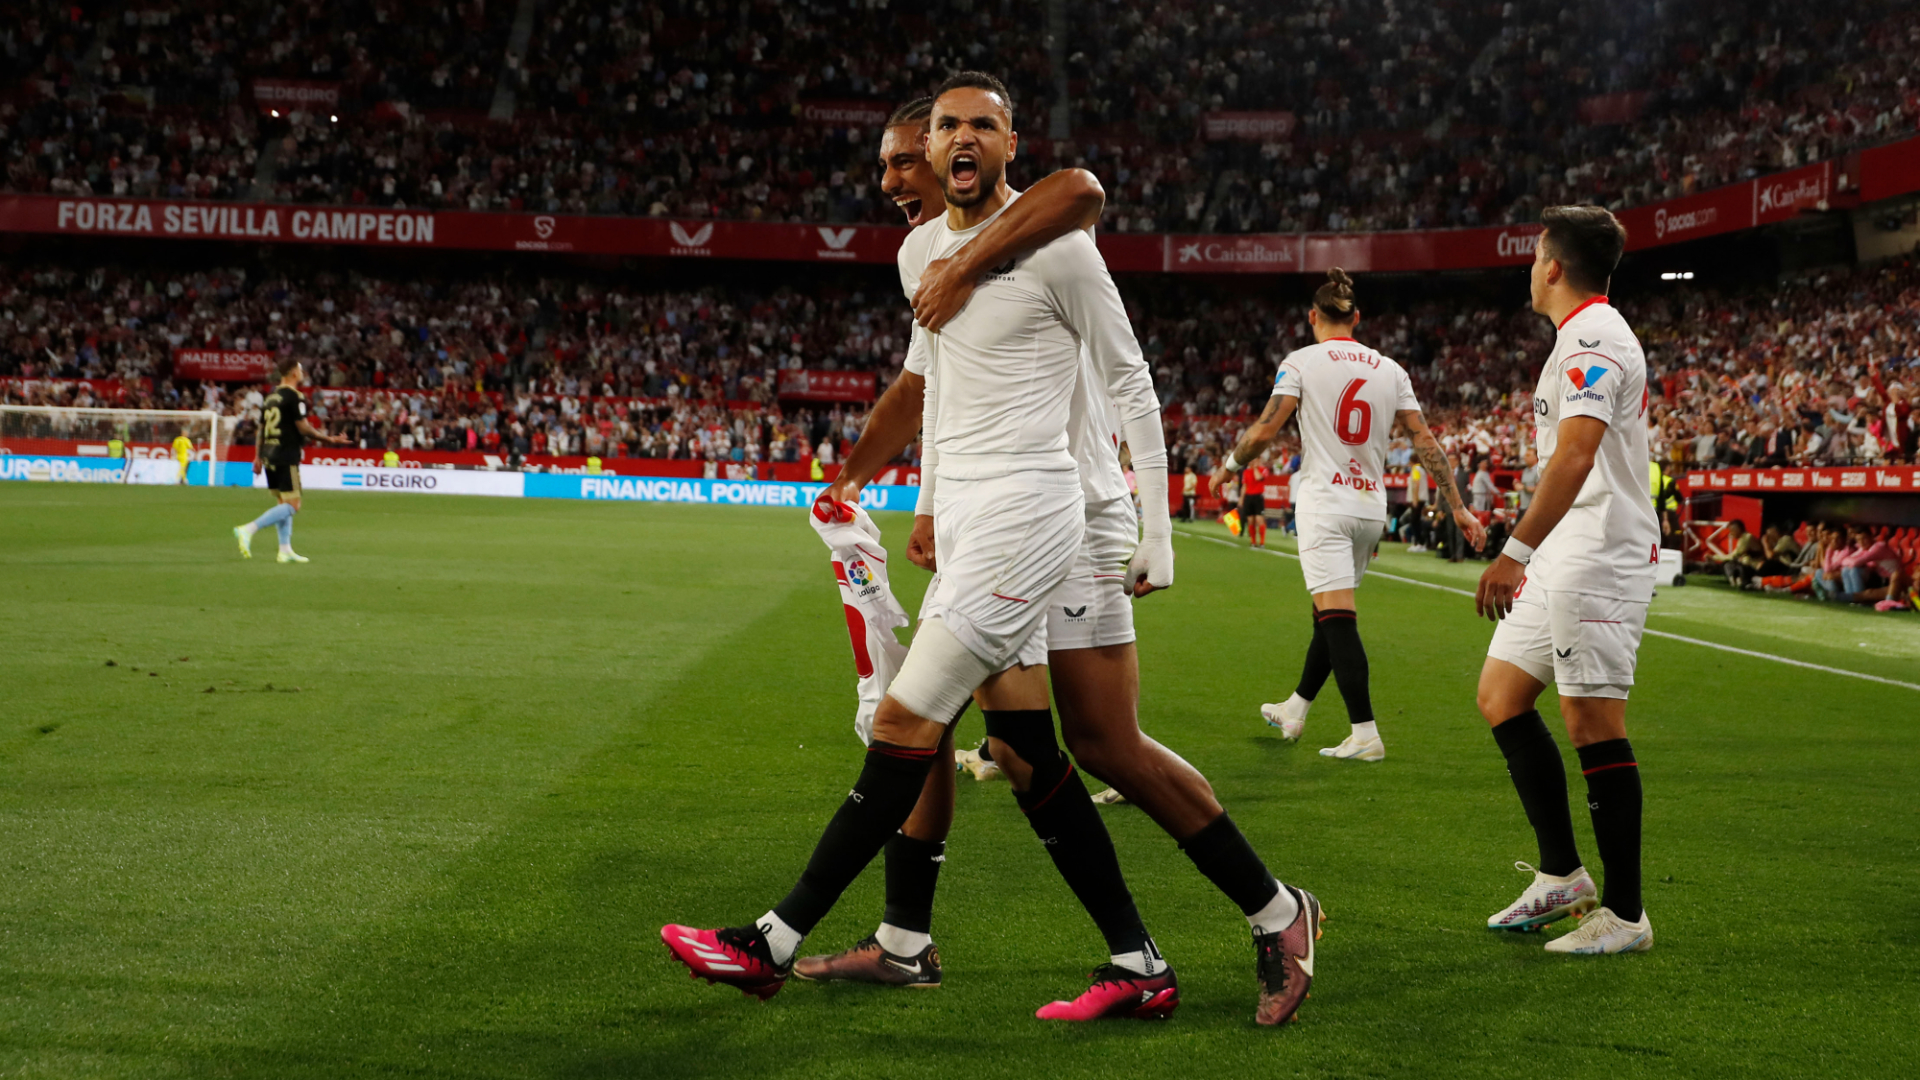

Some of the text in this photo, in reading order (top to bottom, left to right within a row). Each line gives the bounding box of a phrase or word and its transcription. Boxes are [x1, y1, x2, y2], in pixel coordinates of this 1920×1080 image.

[275, 86, 338, 101] DEGIRO
[58, 201, 435, 243] FORZA SEVILLA CAMPEON
[1204, 243, 1293, 263] CaixaBank
[985, 274, 1016, 282] CASTORE
[1327, 350, 1381, 370] GUDELJ
[1333, 377, 1372, 446] 6
[366, 474, 437, 489] DEGIRO
[580, 478, 707, 502] FINANCIAL
[711, 483, 797, 504] POWER
[802, 486, 821, 507] T
